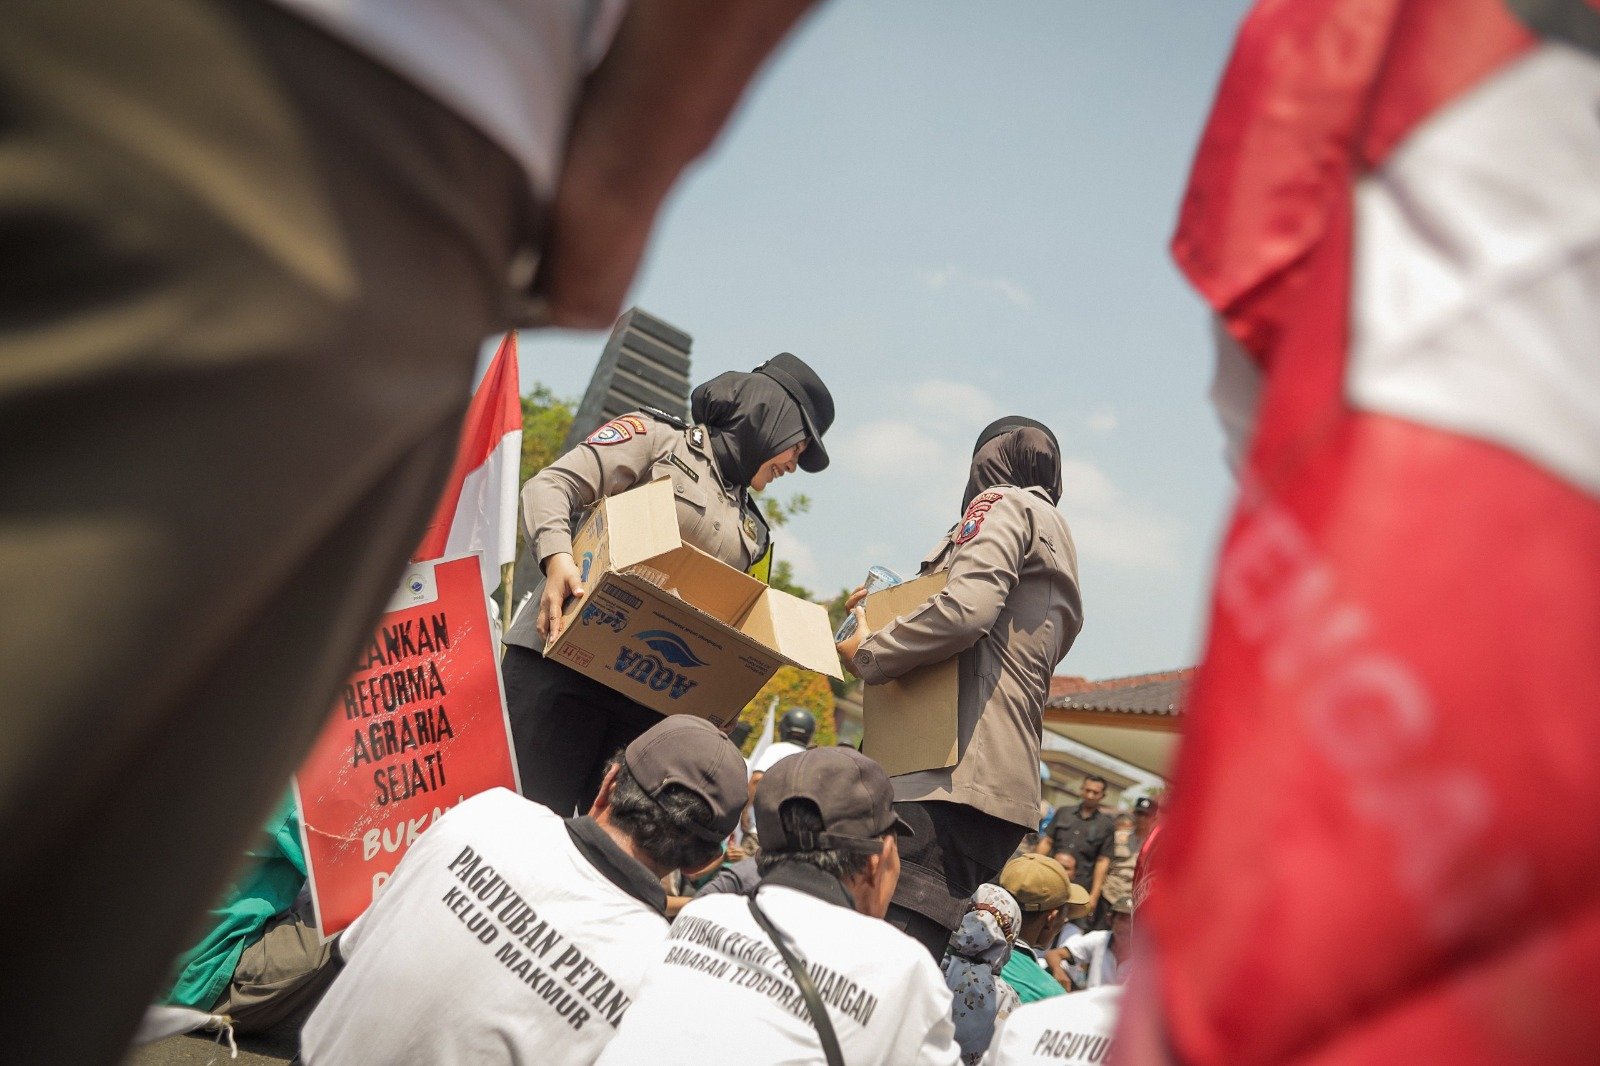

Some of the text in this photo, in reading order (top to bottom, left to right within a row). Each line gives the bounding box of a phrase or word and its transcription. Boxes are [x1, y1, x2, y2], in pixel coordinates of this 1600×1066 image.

[343, 661, 447, 720] REFORMA
[613, 645, 699, 700] AQUA
[353, 705, 454, 768] AGRARIA
[374, 751, 446, 806] SEJATI
[362, 794, 465, 862] BUK
[447, 845, 563, 959] PAGUYUBAN
[441, 886, 499, 945] KELUD
[494, 941, 591, 1031] MAKMUR
[663, 946, 731, 979] BANARAN
[1033, 1029, 1112, 1063] PAGUYU
